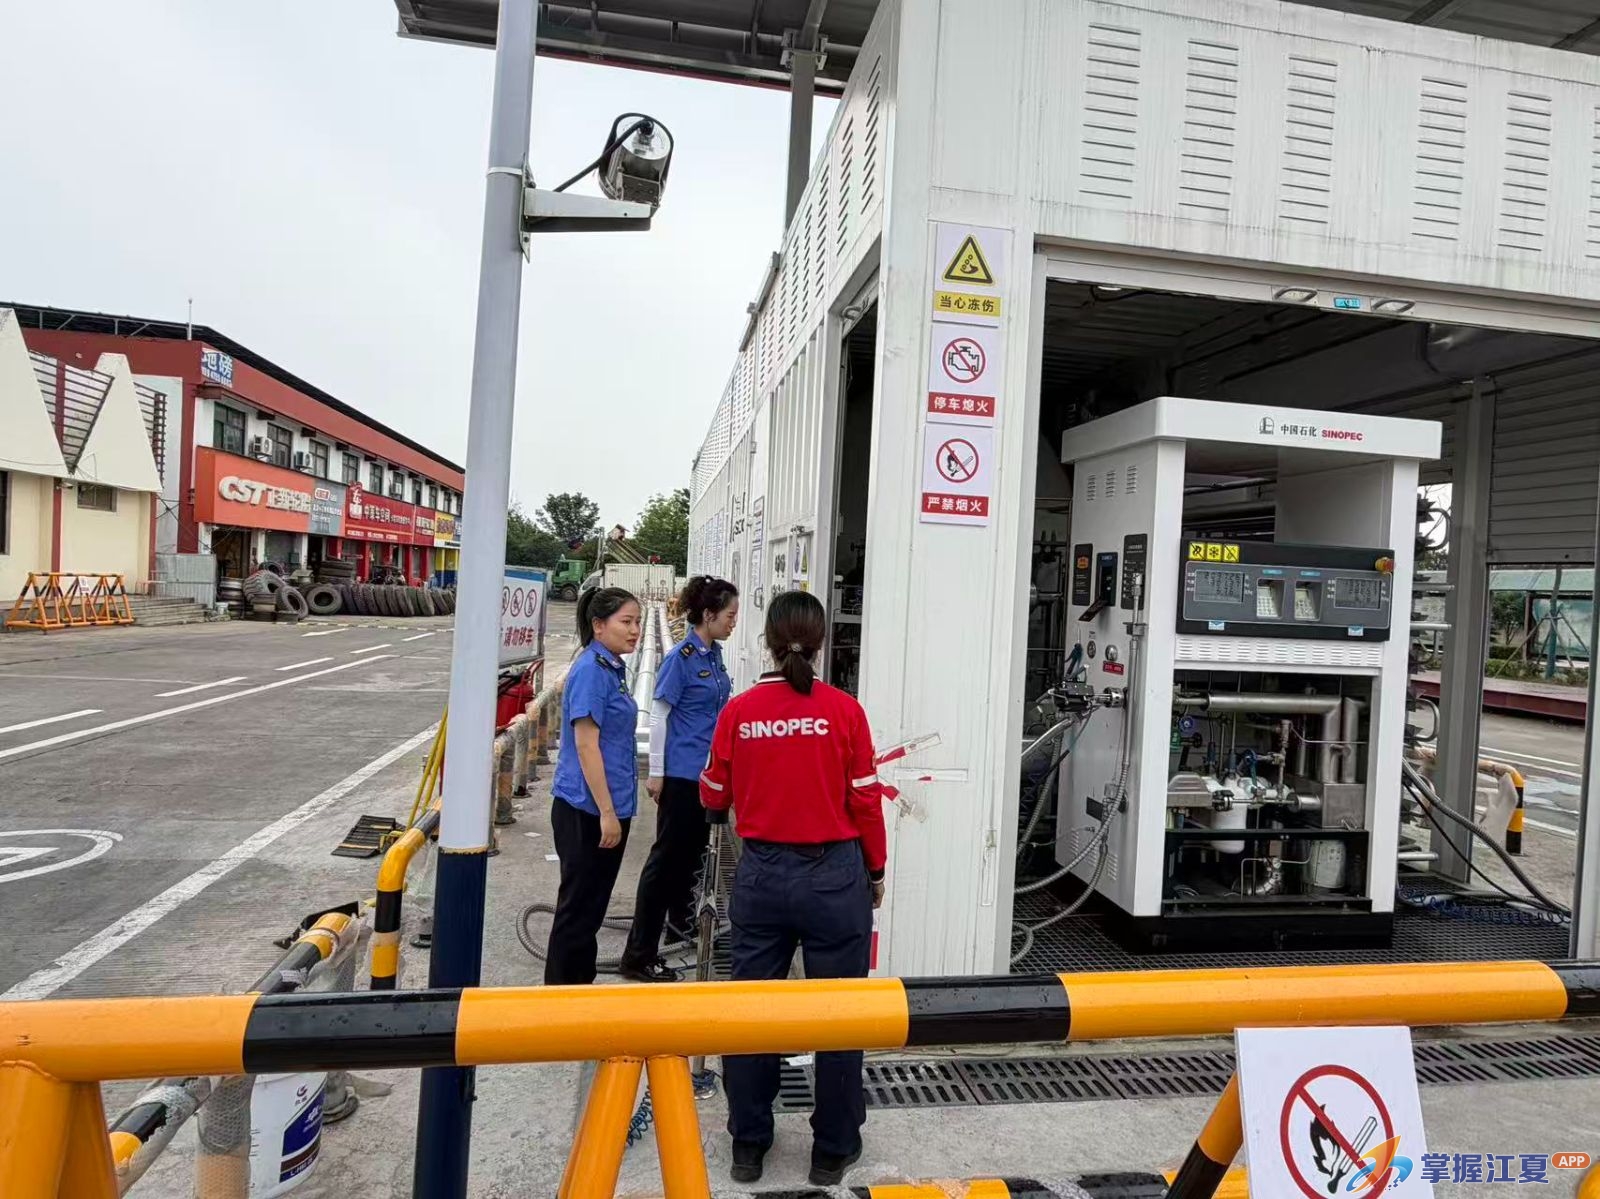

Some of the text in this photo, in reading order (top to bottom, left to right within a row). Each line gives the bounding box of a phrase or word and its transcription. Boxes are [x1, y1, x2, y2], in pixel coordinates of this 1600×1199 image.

[939, 295, 995, 313] 当心冻伤
[933, 396, 989, 413] 停车熄火
[1280, 423, 1363, 441] 中国石化 SINOPEC
[219, 476, 266, 506] CST
[926, 496, 982, 513] 严禁烟火
[738, 717, 830, 739] SINOPEC
